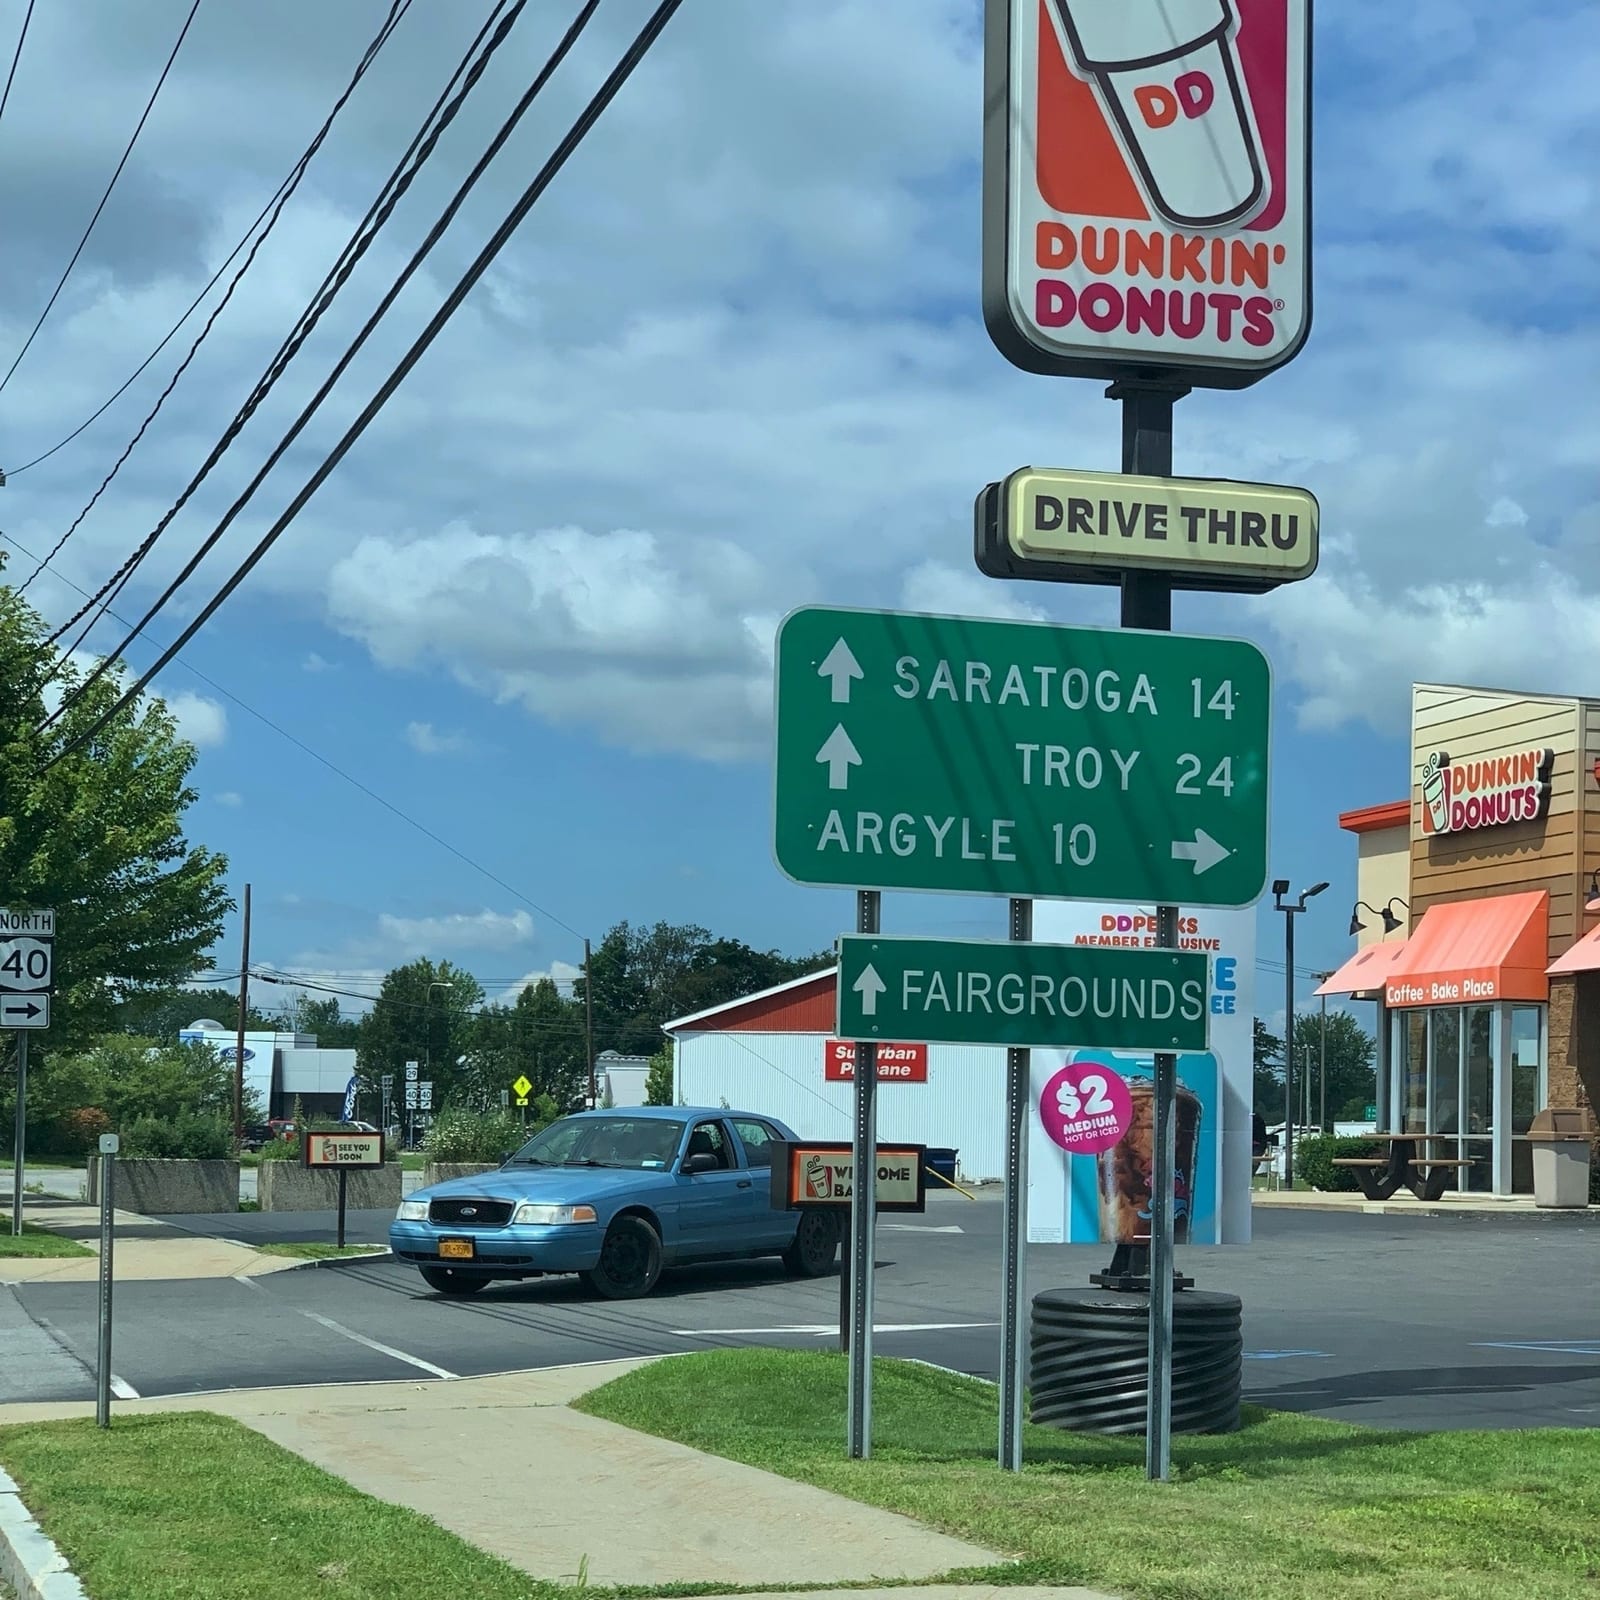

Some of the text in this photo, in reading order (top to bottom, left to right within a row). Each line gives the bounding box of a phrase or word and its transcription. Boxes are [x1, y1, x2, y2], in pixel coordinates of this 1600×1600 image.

[1133, 70, 1214, 129] DD
[1036, 221, 1286, 290] DUNKIN'
[1035, 494, 1299, 551] DRIVE THRU
[893, 655, 1236, 720] SARATOGA 14
[1015, 743, 1235, 797] TROY 24
[1452, 750, 1541, 796] DUNKIN'
[1451, 785, 1537, 830] DONUTS
[816, 809, 1097, 867] ARGYLE 10
[0, 914, 51, 930] NORTH
[1074, 935, 1140, 947] MEMBER
[1, 949, 48, 979] 40
[902, 969, 1203, 1021] FAIRGROUNDS
[1387, 978, 1494, 1003] Coffee Bake Place
[835, 1046, 917, 1060] Surban
[407, 1070, 417, 1079] 29
[840, 1062, 911, 1076] Pane
[407, 1091, 417, 1099] 40
[421, 1091, 431, 1099] 40
[1056, 1074, 1114, 1119] $2
[1063, 1114, 1118, 1135] MEDIUM
[1065, 1126, 1120, 1144] HOT OR ICED
[834, 1166, 910, 1181] WOME
